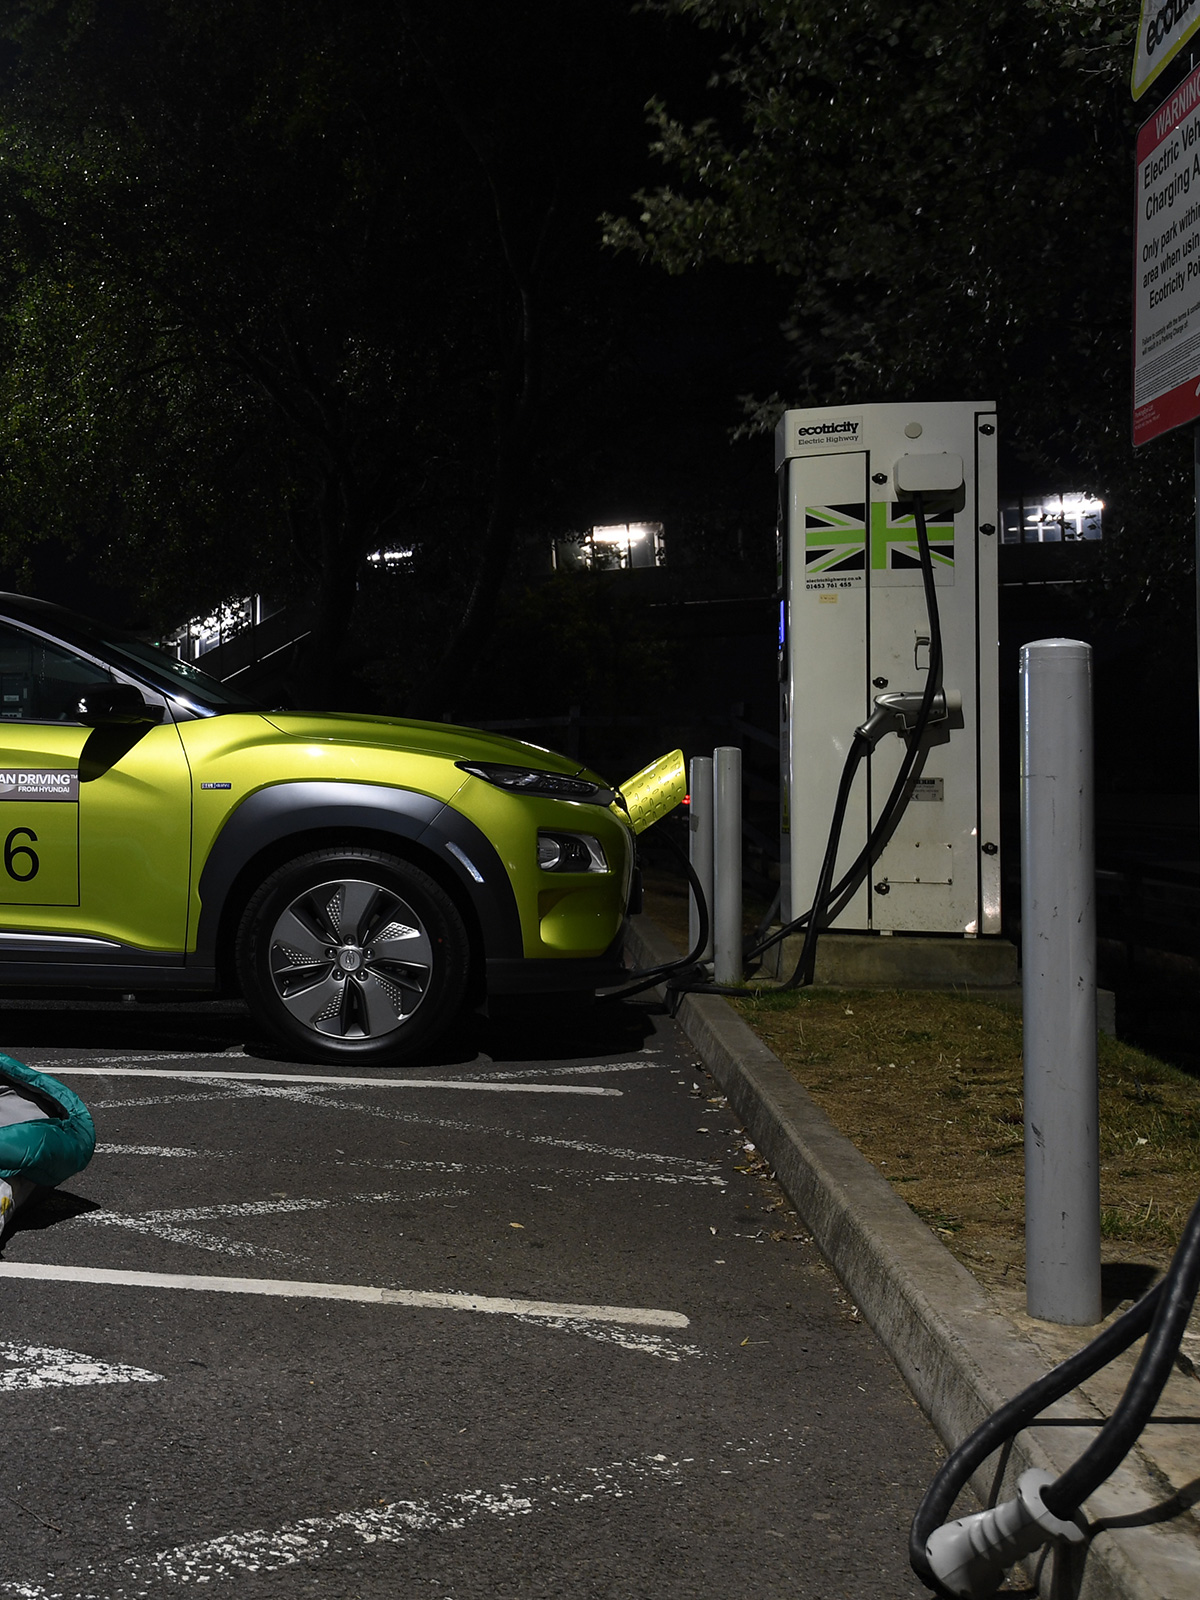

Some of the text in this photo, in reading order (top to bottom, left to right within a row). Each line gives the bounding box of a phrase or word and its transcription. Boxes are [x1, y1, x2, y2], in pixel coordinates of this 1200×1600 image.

[1144, 140, 1180, 189] Electric
[1145, 166, 1190, 221] Charging
[1143, 237, 1160, 263] Only
[1160, 221, 1178, 253] park
[1143, 265, 1159, 288] area
[1160, 248, 1181, 275] when
[1149, 271, 1186, 309] Ecotricity
[798, 421, 859, 436] ecotricity
[798, 435, 859, 446] Electric Highway
[4, 827, 39, 882] 6
